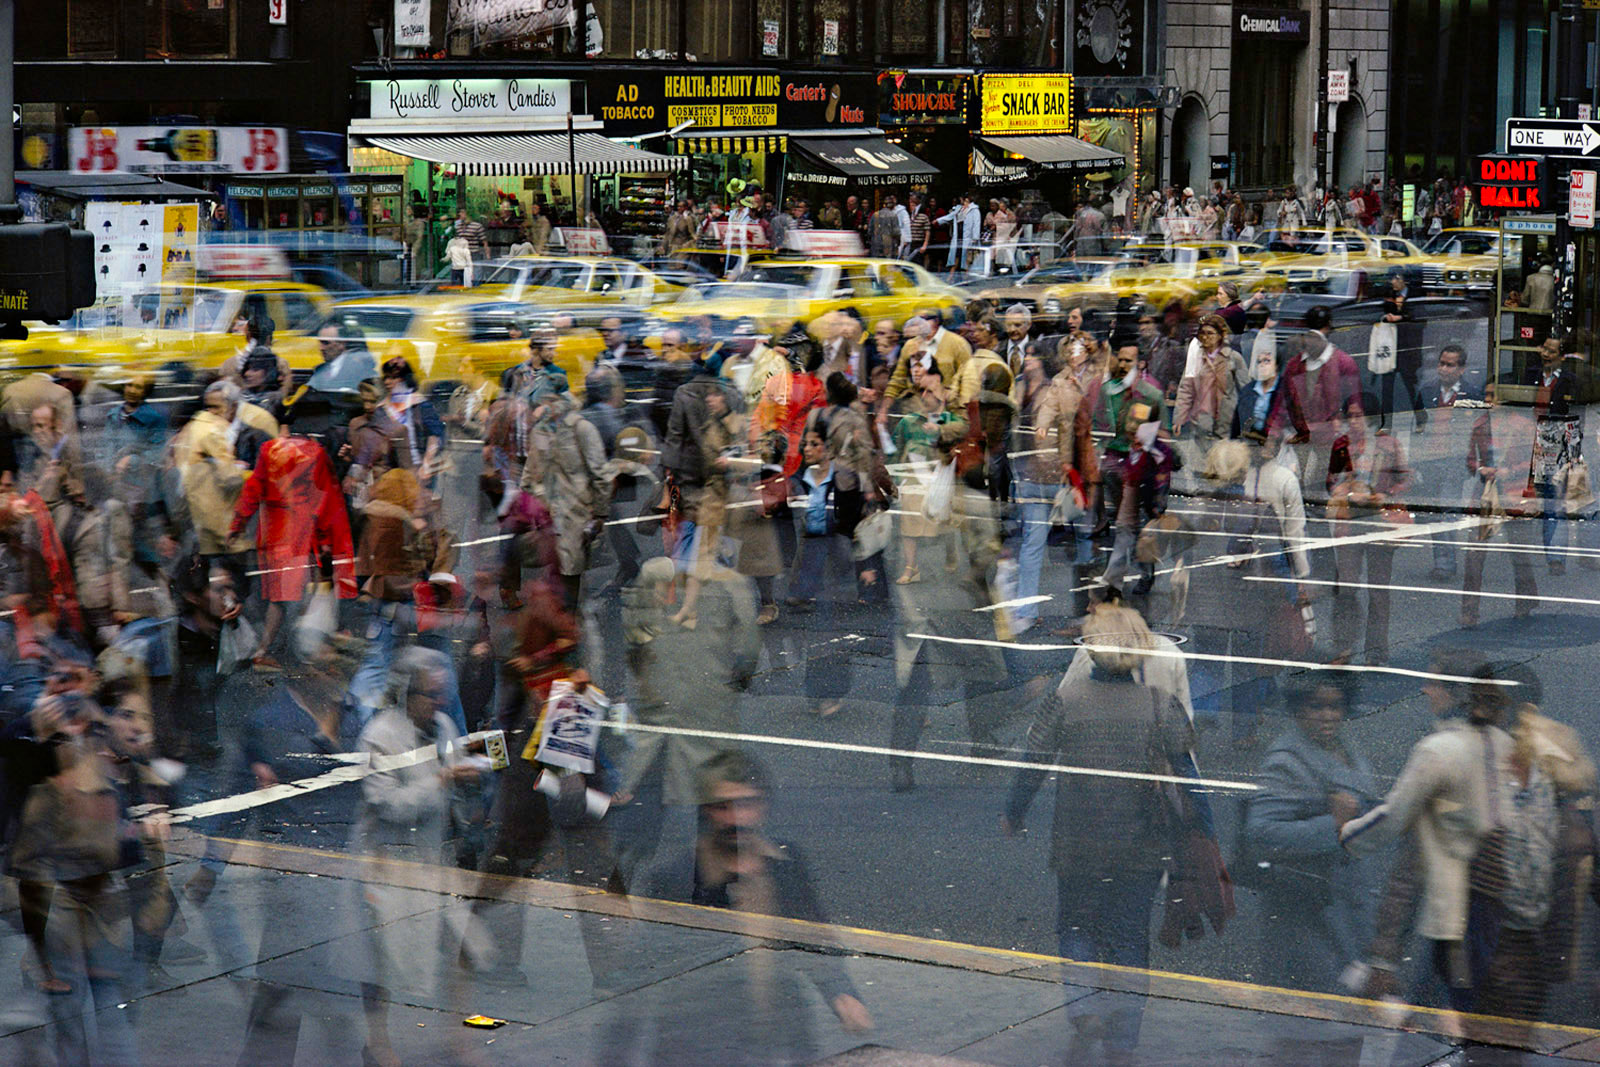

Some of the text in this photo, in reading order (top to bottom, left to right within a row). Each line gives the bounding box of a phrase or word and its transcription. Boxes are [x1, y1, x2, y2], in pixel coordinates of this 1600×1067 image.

[755, 75, 780, 97] AIDS
[786, 82, 826, 101] Carter's
[387, 79, 557, 118] Russell Stover Candies
[616, 84, 639, 102] AD
[892, 93, 956, 111] SHOWCASE
[1002, 93, 1040, 116] SNACK
[1044, 93, 1065, 115] BAR
[601, 106, 655, 120] TOBACCO
[671, 106, 717, 116] COSMETICS
[725, 105, 775, 116] PHOTO NEEDS
[840, 105, 864, 123] Nuts
[732, 116, 768, 125] TOBACCO
[1515, 131, 1592, 146] ONE WAY
[1481, 160, 1538, 181] DONT
[808, 174, 828, 183] DRIED
[828, 176, 848, 186] FRUIT
[858, 176, 879, 186] NUTS
[887, 175, 908, 184] DRIED
[1571, 173, 1583, 186] NO
[229, 186, 263, 196] TELEPHONE
[269, 187, 298, 196] TELEPHONE
[304, 185, 333, 195] TELEPHONE
[338, 184, 367, 194] TELEPHONE
[373, 184, 401, 193] TELEPHONE
[1480, 186, 1540, 208] WALK
[1572, 191, 1592, 199] PARKING
[1518, 221, 1553, 229] phone
